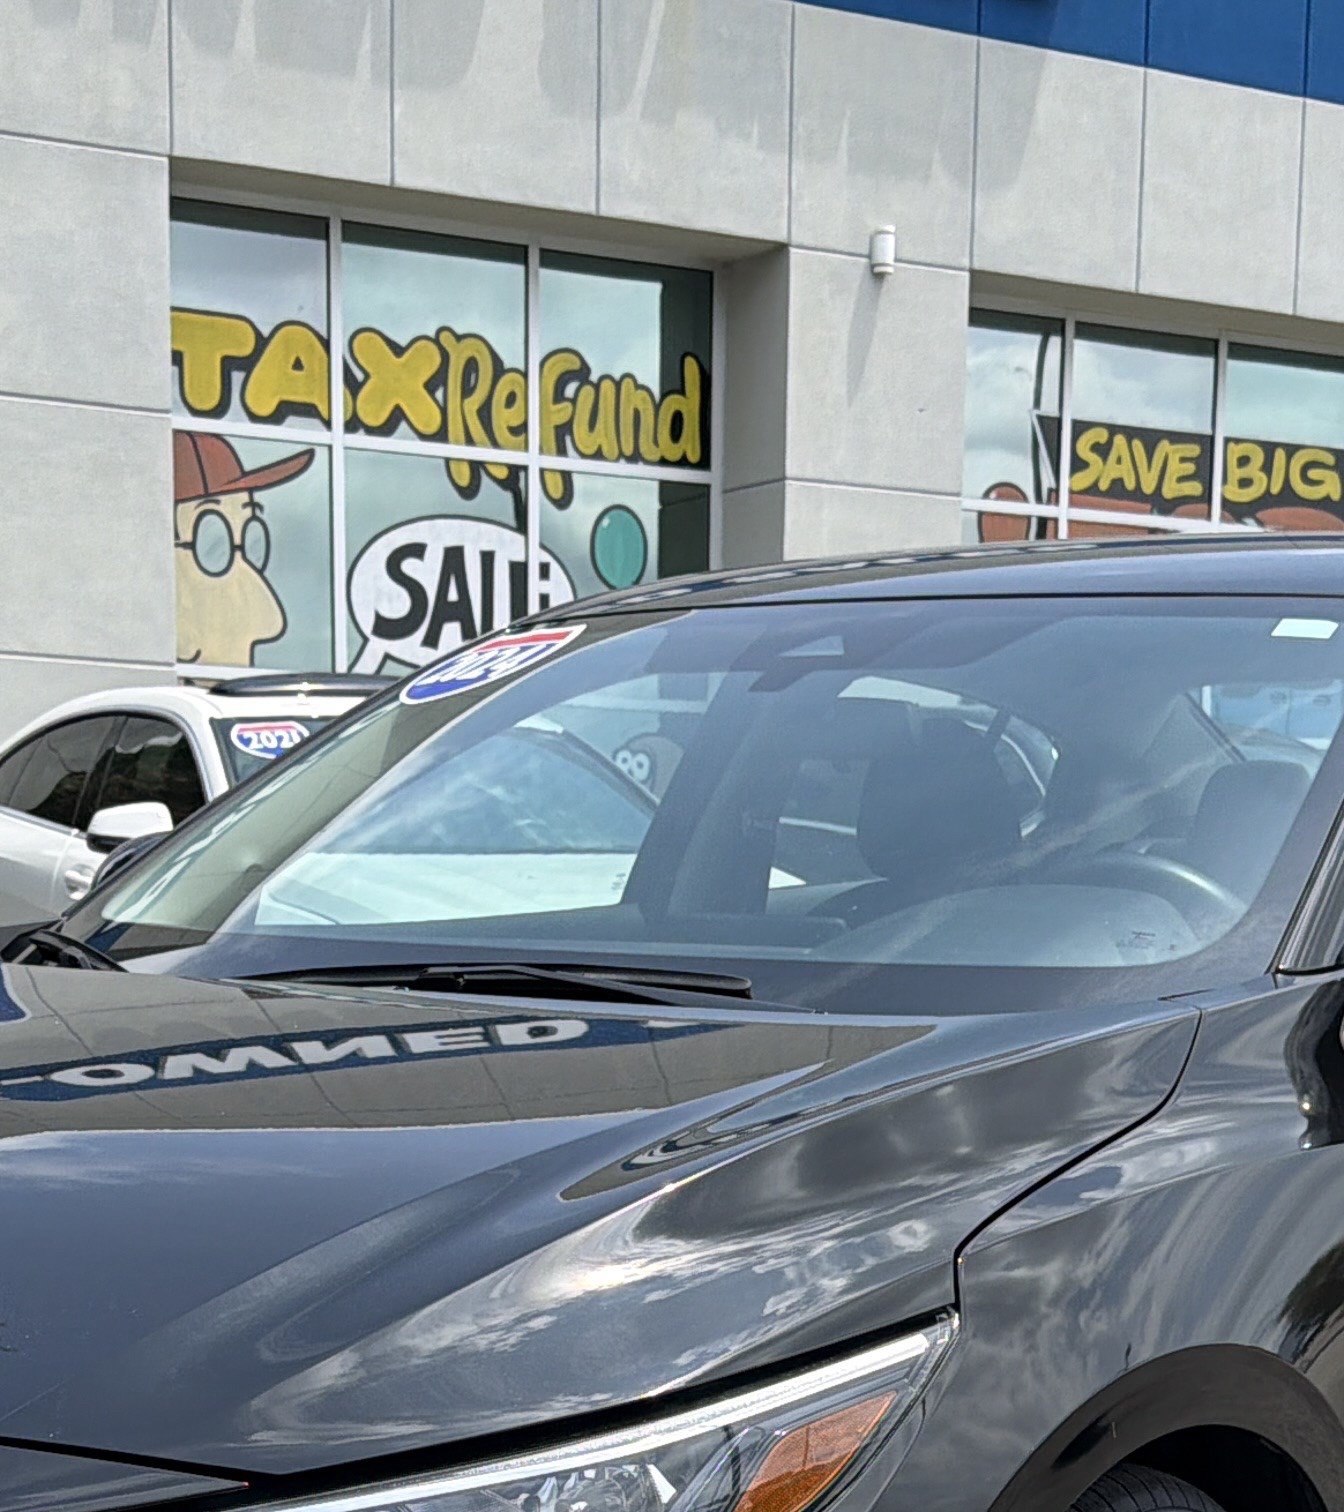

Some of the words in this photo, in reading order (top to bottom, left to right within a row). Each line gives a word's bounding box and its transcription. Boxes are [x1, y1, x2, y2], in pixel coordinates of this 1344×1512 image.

[171, 307, 443, 435] TAX
[1068, 427, 1203, 499] SAVE
[1223, 442, 1341, 502] BIG
